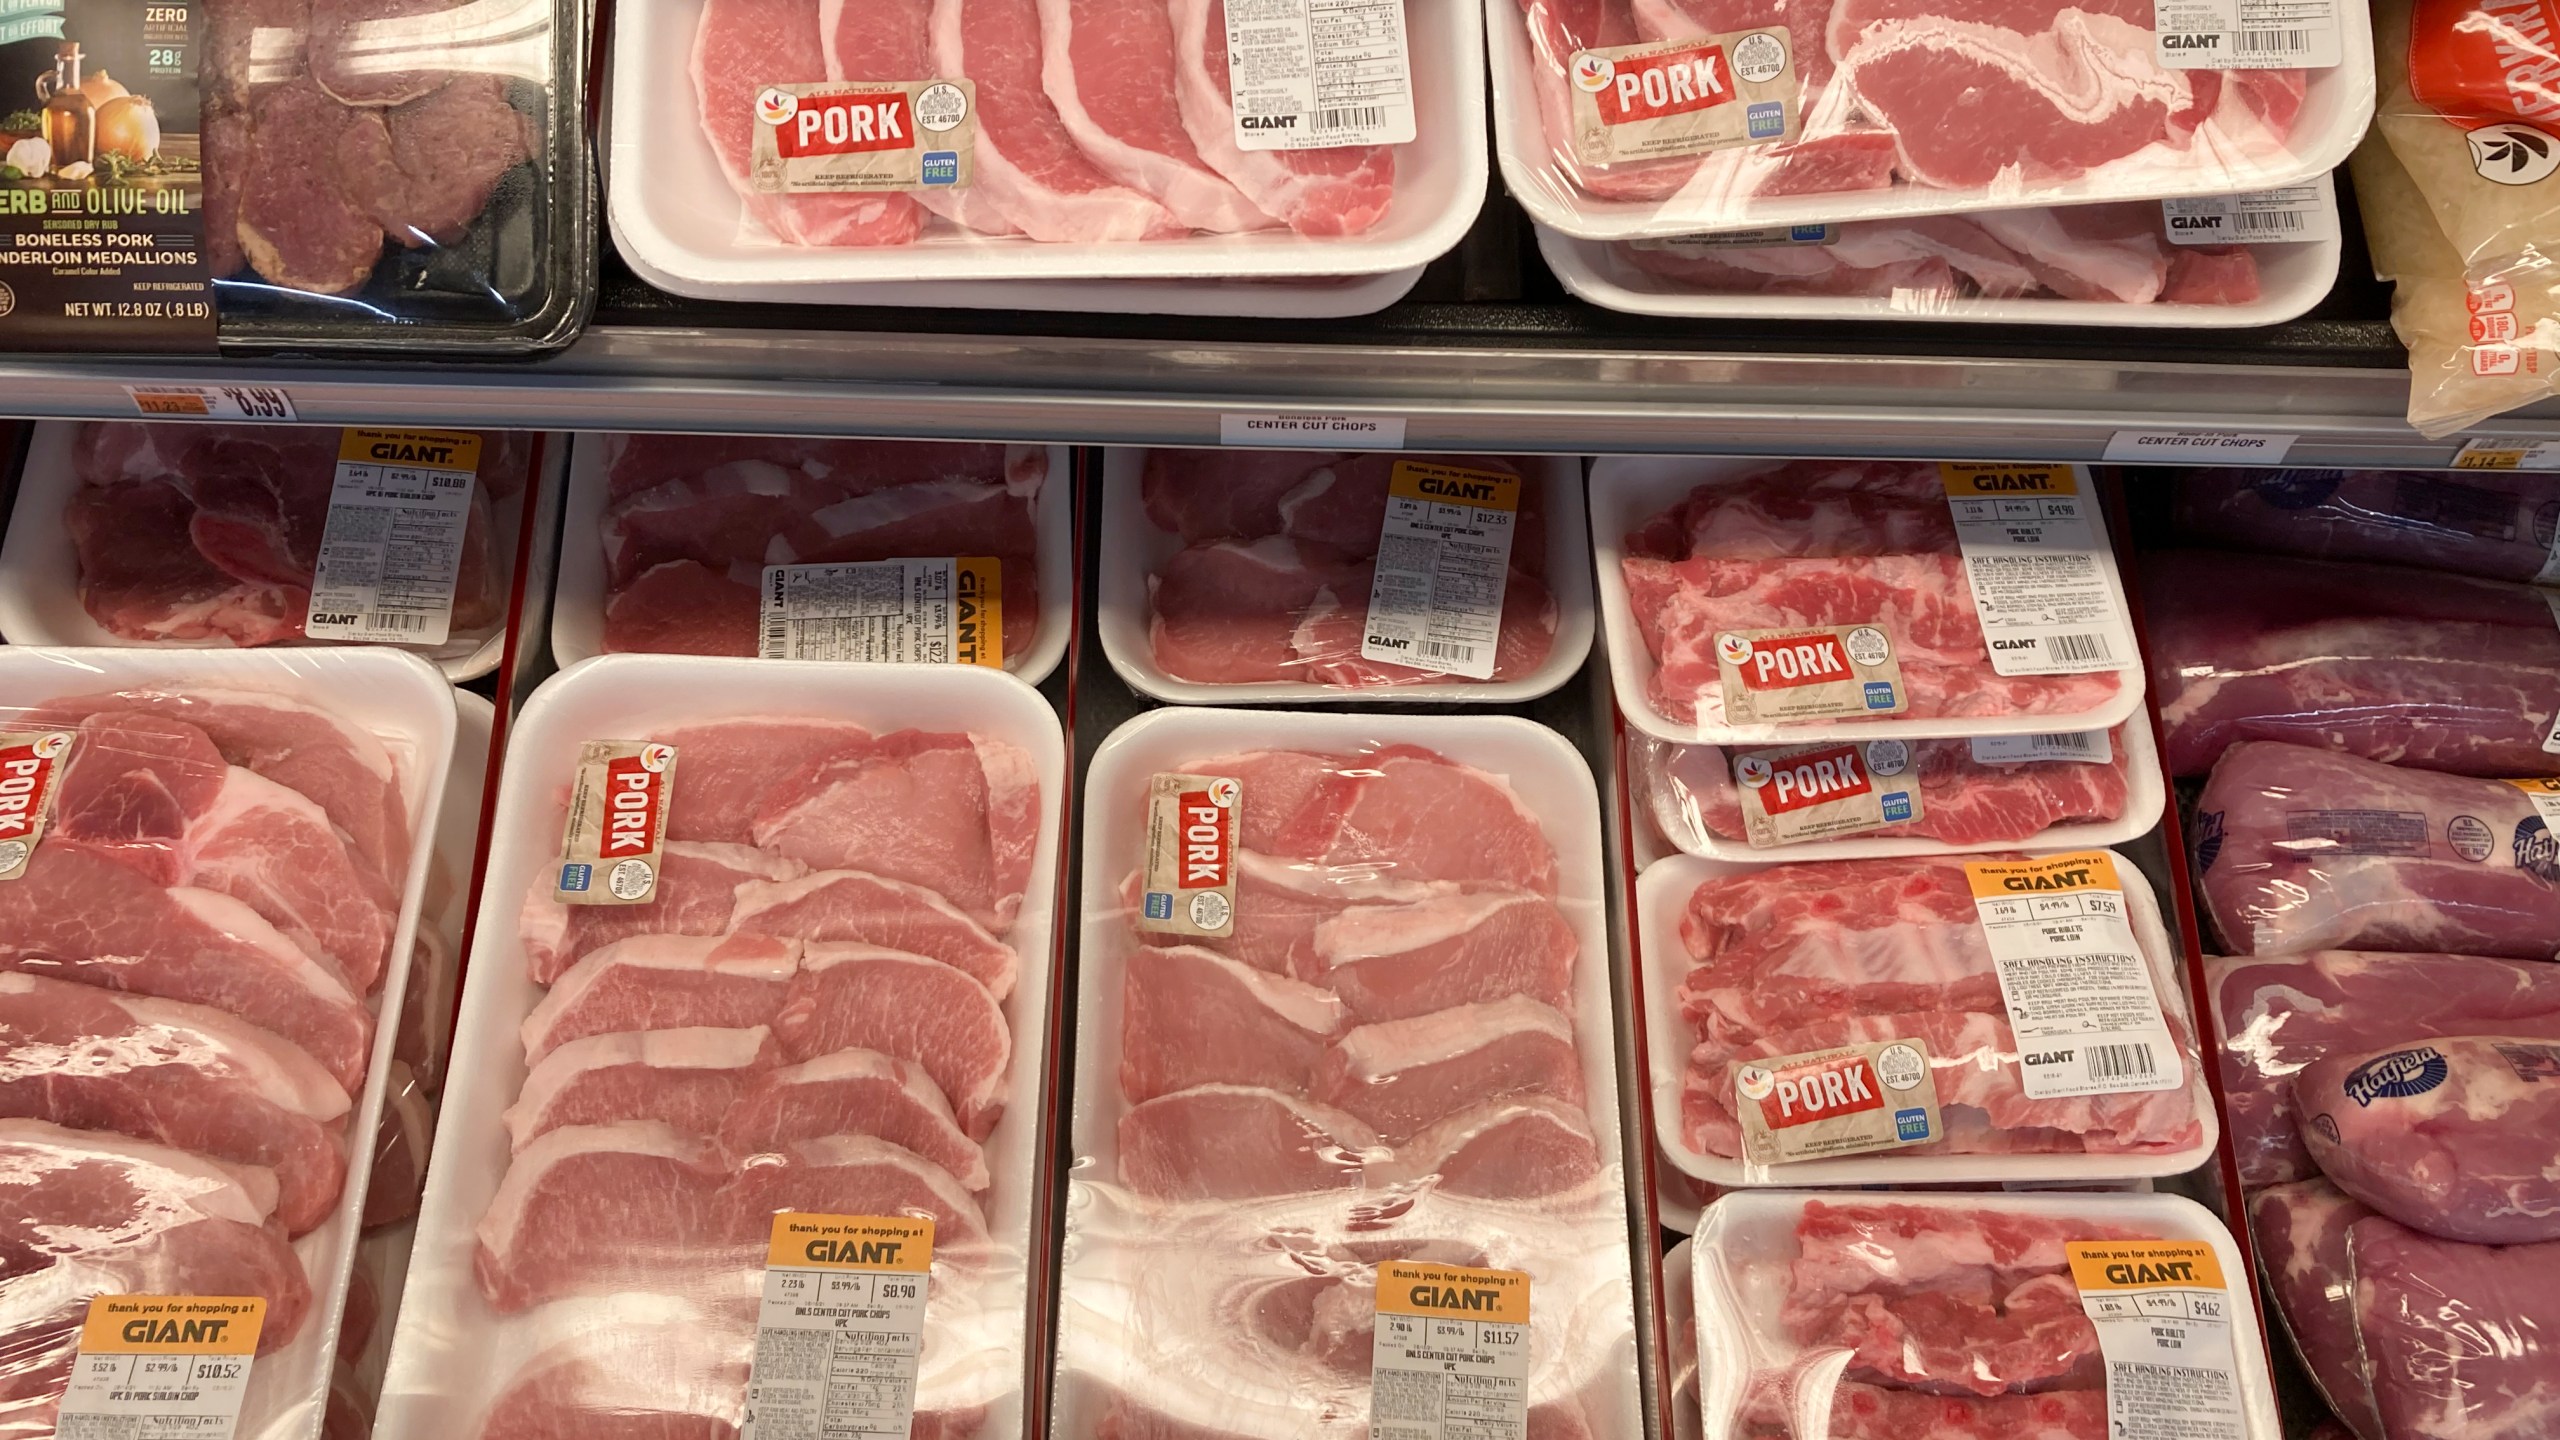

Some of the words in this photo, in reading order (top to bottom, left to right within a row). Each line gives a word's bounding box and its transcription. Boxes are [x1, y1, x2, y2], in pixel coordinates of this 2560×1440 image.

[146, 8, 187, 22] ZERO
[20, 18, 58, 35] EFFORT
[2162, 35, 2220, 48] GIANT
[150, 50, 181, 66] 28g
[1740, 67, 1756, 77] EST.
[1757, 64, 1780, 74] 46700
[1616, 56, 1724, 113] PORK
[922, 115, 937, 124] EST.
[938, 113, 960, 124] 46700
[1749, 109, 1781, 120] GLUTEN
[798, 101, 903, 147] PORK
[1241, 115, 1297, 129] GIANT
[1751, 118, 1781, 132] FREE
[924, 158, 956, 168] GLUTEN
[925, 167, 954, 178] FREE
[51, 192, 80, 210] AND
[87, 188, 147, 214] OLIVE
[156, 189, 189, 214] OIL
[43, 220, 82, 229] SEASONED
[84, 220, 100, 229] DRY
[102, 220, 118, 229] RUB
[2171, 216, 2222, 229] GIANT
[15, 234, 102, 247] BONELESS
[107, 234, 154, 247] PORK
[87, 252, 197, 265] MEDALLIONS
[53, 267, 80, 276] Caramel
[81, 267, 98, 276] Color
[100, 267, 121, 276] Added
[133, 282, 151, 291] KEEP
[152, 282, 204, 291] REFRIGERATED
[65, 303, 90, 317] NET
[93, 303, 115, 317] WT.
[119, 303, 142, 317] 12.8
[145, 303, 162, 317] OZ
[166, 302, 184, 318] (.8
[187, 302, 209, 318] LB)
[1247, 420, 1298, 430] CENTER
[1302, 421, 1329, 430] CUT
[1332, 422, 1377, 431] CHOPS
[2138, 436, 2189, 446] CENTER
[2191, 438, 2219, 447] CUT
[2221, 439, 2266, 448] CHOPS
[370, 443, 452, 464] GIANT
[1973, 473, 2050, 491] GIANT
[1419, 478, 1495, 501] GIANT
[2047, 504, 2075, 516] $4.98
[1476, 513, 1507, 525] $12.33
[1971, 557, 1989, 565] SAFE
[1993, 556, 2032, 565] HANDLING
[2035, 555, 2091, 563] INSTRUCTIONS
[774, 569, 785, 608] GIANT
[312, 613, 358, 626] GIANT
[959, 570, 976, 663] GIANT
[1368, 635, 1410, 650] GIANT
[1993, 639, 2037, 650] GIANT
[1754, 642, 1843, 683] PORK
[1854, 653, 1867, 661] EST.
[1868, 651, 1885, 660] 46700
[1866, 687, 1891, 695] GLUTEN
[1868, 694, 1892, 704] FREE
[1873, 762, 1886, 771] EST.
[1887, 760, 1905, 768] 46700
[1774, 753, 1861, 804] PORK
[0, 759, 41, 830] PORK
[1883, 797, 1909, 807] GLUTEN
[611, 772, 650, 850] PORK
[1885, 806, 1909, 817] FREE
[1187, 807, 1220, 881] PORK
[618, 864, 626, 875] EST.
[1980, 867, 2008, 875] thank
[2010, 865, 2028, 875] you
[2029, 864, 2044, 874] for
[2046, 857, 2092, 871] shopping
[2093, 857, 2104, 865] at
[566, 866, 578, 888] FREE
[576, 865, 586, 890] GLUTEN
[2003, 869, 2090, 891] GIANT
[614, 876, 624, 895] 46700
[1150, 895, 1160, 916] FREE
[1159, 894, 1167, 918] GLUTEN
[2090, 899, 2117, 914] $7.59
[2042, 926, 2056, 935] PORK
[2058, 925, 2083, 934] RIBLETS
[2003, 960, 2024, 969] SAFE
[2028, 957, 2073, 967] HANDLING
[2075, 954, 2136, 964] INSTRUCTIONS
[2024, 1050, 2074, 1065] GIANT
[1886, 1075, 1900, 1084] EST.
[1901, 1072, 1921, 1082] 46700
[2346, 1047, 2438, 1107] Hatfield
[1776, 1064, 1872, 1118] PORK
[1897, 1114, 1925, 1124] GLUTEN
[1900, 1122, 1926, 1135] FREE
[1823, 1134, 1873, 1146] REFRIGERATED
[789, 1224, 819, 1233] thank
[821, 1226, 841, 1236] you
[844, 1226, 858, 1234] for
[862, 1226, 910, 1238] shopping
[805, 1240, 902, 1264] GIANT
[2081, 1251, 2109, 1259] thank
[2111, 1250, 2129, 1260] you
[2131, 1250, 2145, 1258] for
[2148, 1249, 2193, 1259] shopping
[1393, 1269, 1421, 1279] thank
[1423, 1272, 1441, 1281] you
[1444, 1272, 1457, 1281] for
[1460, 1275, 1505, 1286] shopping
[1508, 1277, 1519, 1285] at
[2106, 1262, 2193, 1284] GIANT
[831, 1281, 860, 1291] $3.99/lb
[883, 1284, 916, 1299] $8.90
[1410, 1285, 1500, 1312] GIANT
[108, 1303, 139, 1313] thank
[142, 1305, 162, 1314] you
[167, 1303, 182, 1312] for
[186, 1303, 238, 1314] shopping
[242, 1304, 254, 1312] at
[795, 1307, 812, 1317] BNLS
[813, 1307, 837, 1317] CENTER
[838, 1308, 850, 1318] CUT
[852, 1309, 868, 1318] PORK
[869, 1309, 890, 1319] CHOPS
[2194, 1302, 2220, 1316] $4.62
[835, 1319, 847, 1328] UPK
[122, 1319, 228, 1343] GIANT
[1437, 1327, 1464, 1336] $3.99/lb
[1483, 1330, 1519, 1345] $11.57
[1405, 1350, 1421, 1358] BNLS
[1422, 1351, 1444, 1361] CENTER
[1446, 1352, 1458, 1361] CUT
[1459, 1353, 1474, 1363] PORK
[1476, 1354, 1495, 1365] CHOPS
[145, 1363, 178, 1373] $2.99/lb
[197, 1364, 241, 1379] $10.52
[1444, 1362, 1456, 1371] UPK
[2113, 1363, 2132, 1373] SAFE
[2135, 1365, 2171, 1376] HANDLING
[2173, 1367, 2228, 1380] INSTRUCTIONS
